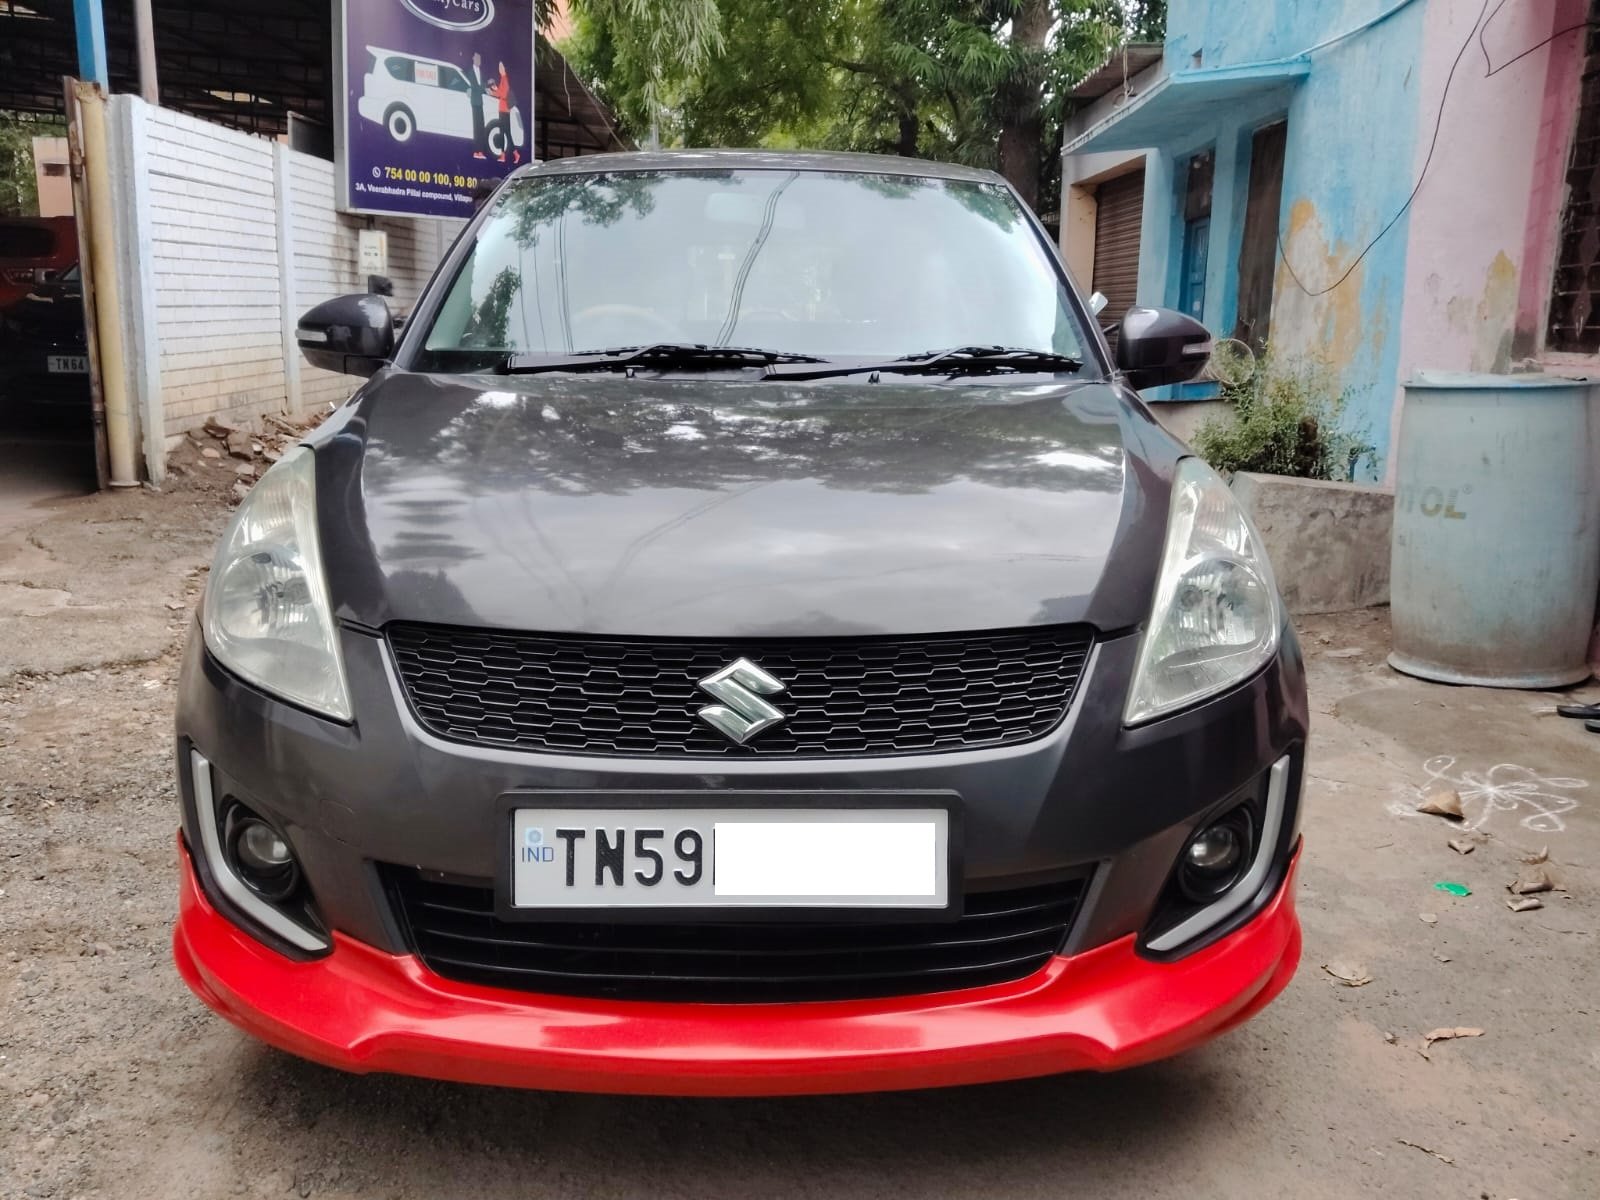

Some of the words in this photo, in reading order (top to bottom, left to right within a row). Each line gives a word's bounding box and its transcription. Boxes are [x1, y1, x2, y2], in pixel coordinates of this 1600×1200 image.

[440, 0, 480, 12] yCars
[384, 166, 402, 180] 754
[404, 169, 417, 182] 00
[419, 171, 431, 184] 00
[433, 173, 452, 188] 100,
[453, 176, 465, 188] 90
[355, 182, 367, 192] 3A,
[367, 184, 405, 196] Veerabhadra
[422, 191, 454, 202] compound,
[56, 358, 84, 370] TN64
[521, 846, 555, 863] IND
[556, 829, 715, 887] TN59
